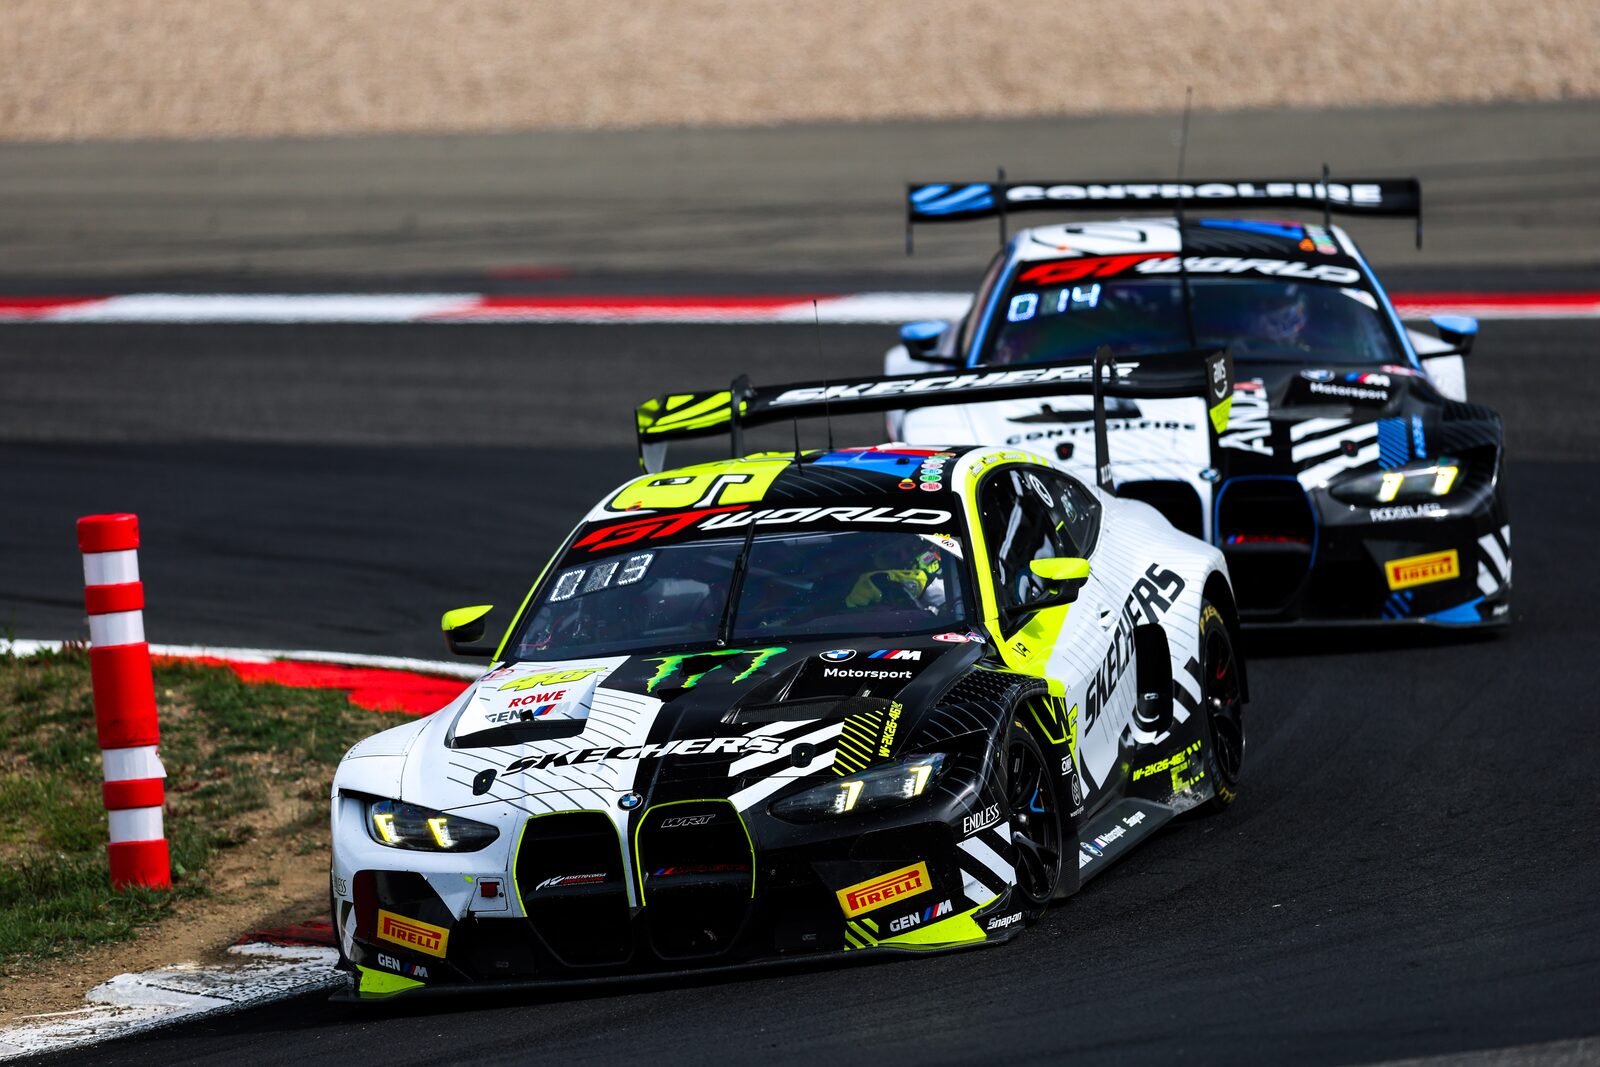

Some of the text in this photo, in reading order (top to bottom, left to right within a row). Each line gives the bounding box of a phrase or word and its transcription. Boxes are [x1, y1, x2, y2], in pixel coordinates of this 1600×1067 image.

[1006, 183, 1382, 206] CONTROLFIRE
[1309, 382, 1388, 400] Motorsport
[1393, 556, 1452, 583] PIRELLI
[823, 668, 913, 680] Motorsport
[508, 689, 567, 709] ROWE
[500, 736, 785, 777] SKECHERS
[661, 814, 716, 829] WRT
[963, 802, 1000, 834] ENDLESS
[845, 869, 923, 911] PIRELLI
[889, 911, 921, 932] GEN
[986, 911, 1023, 930] Snap-on
[383, 916, 442, 951] PIRELLI
[377, 953, 401, 972] GEN
